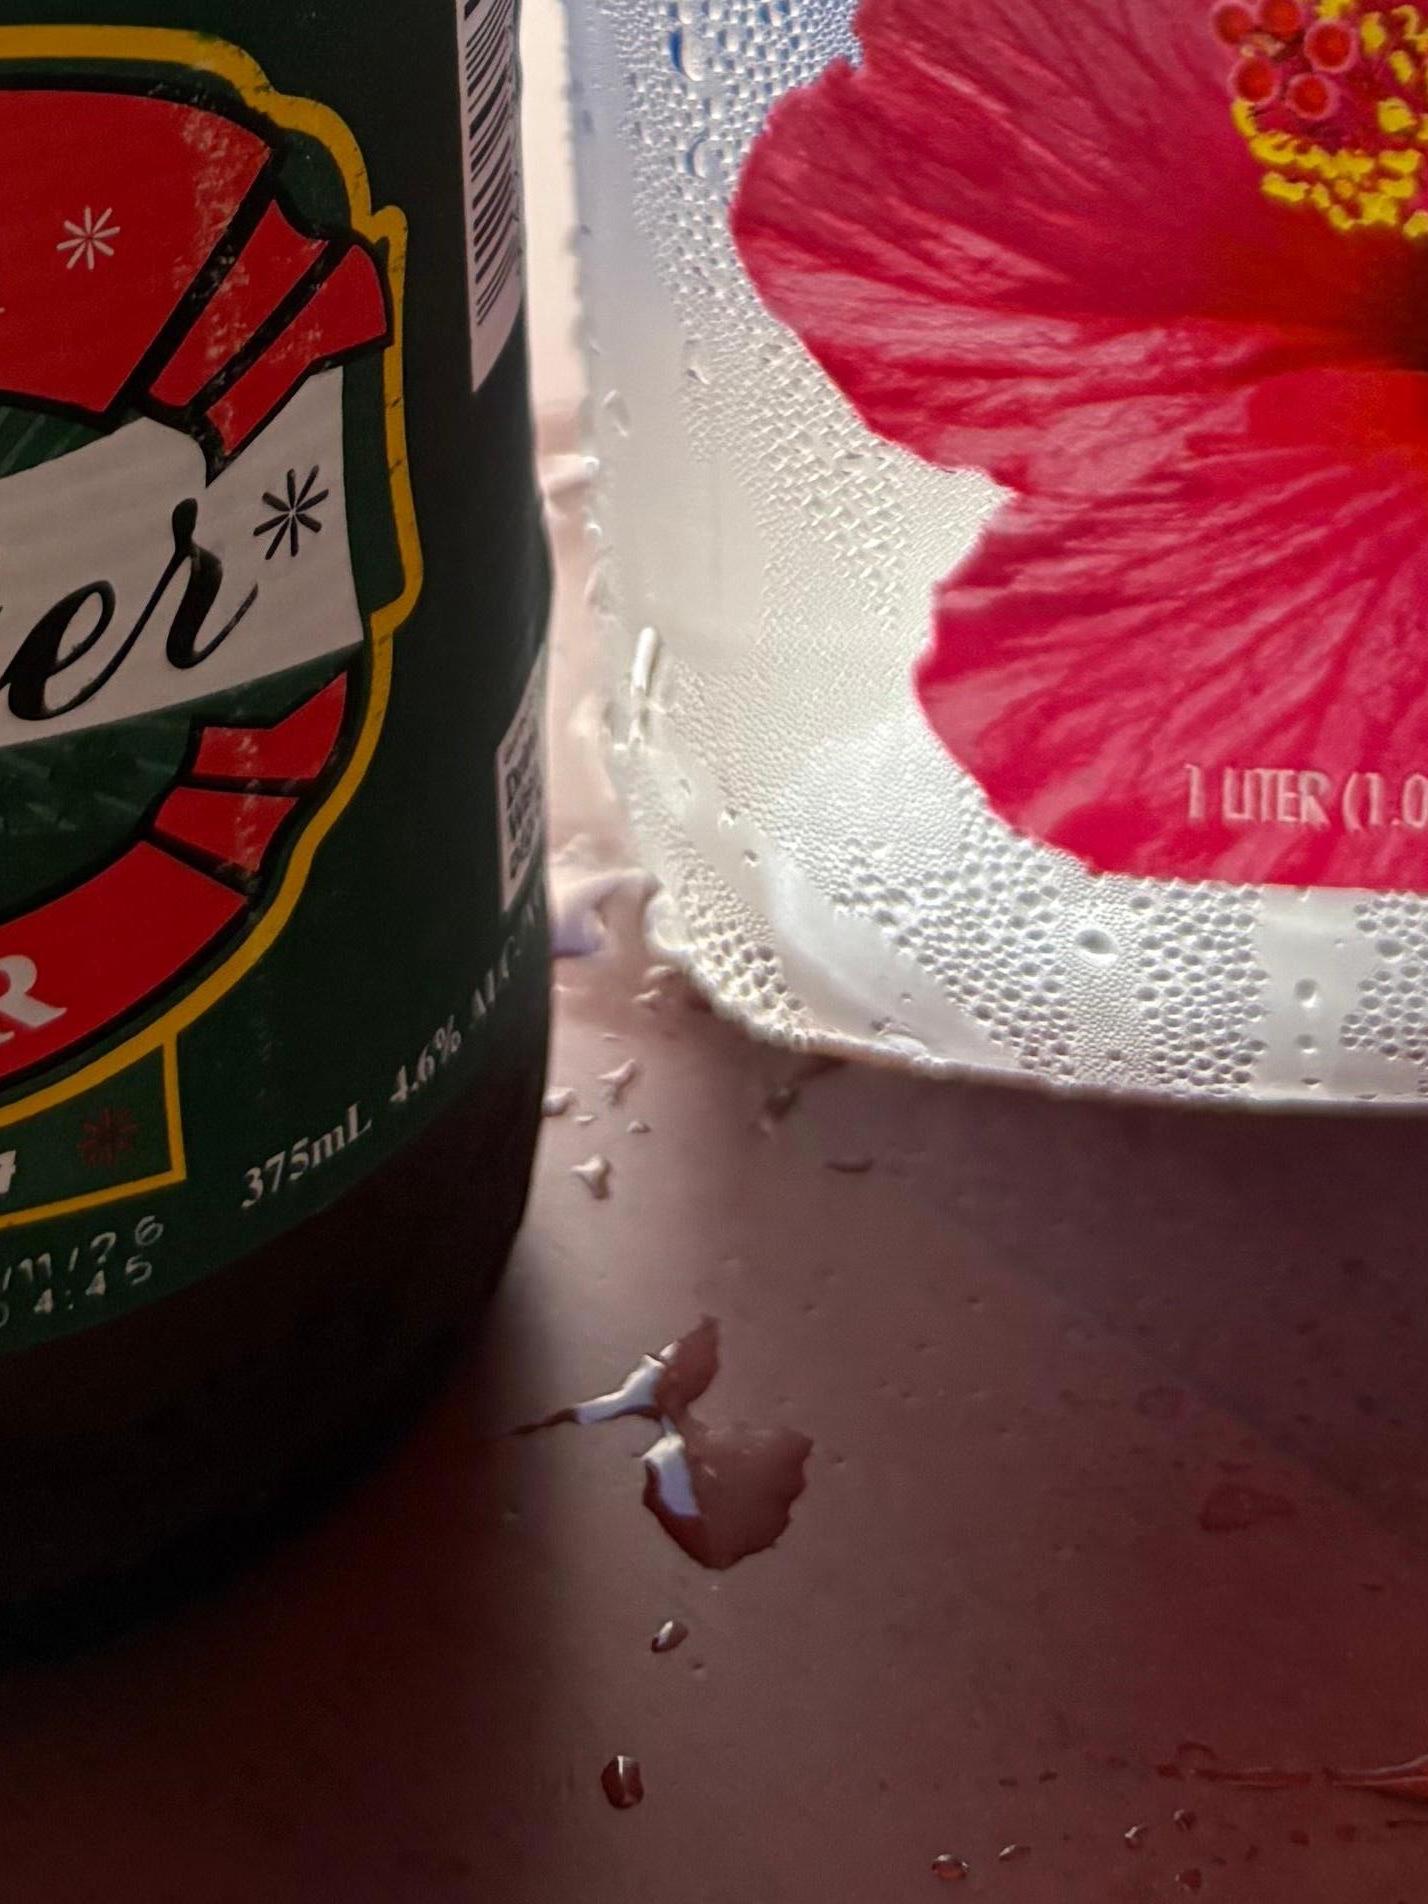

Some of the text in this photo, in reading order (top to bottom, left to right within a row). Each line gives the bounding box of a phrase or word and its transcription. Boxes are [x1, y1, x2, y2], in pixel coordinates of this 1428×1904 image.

[1183, 763, 1205, 821] 1
[1223, 766, 1332, 827] LITER
[240, 1099, 373, 1209] 375mL
[389, 1013, 462, 1105] 4.6%
